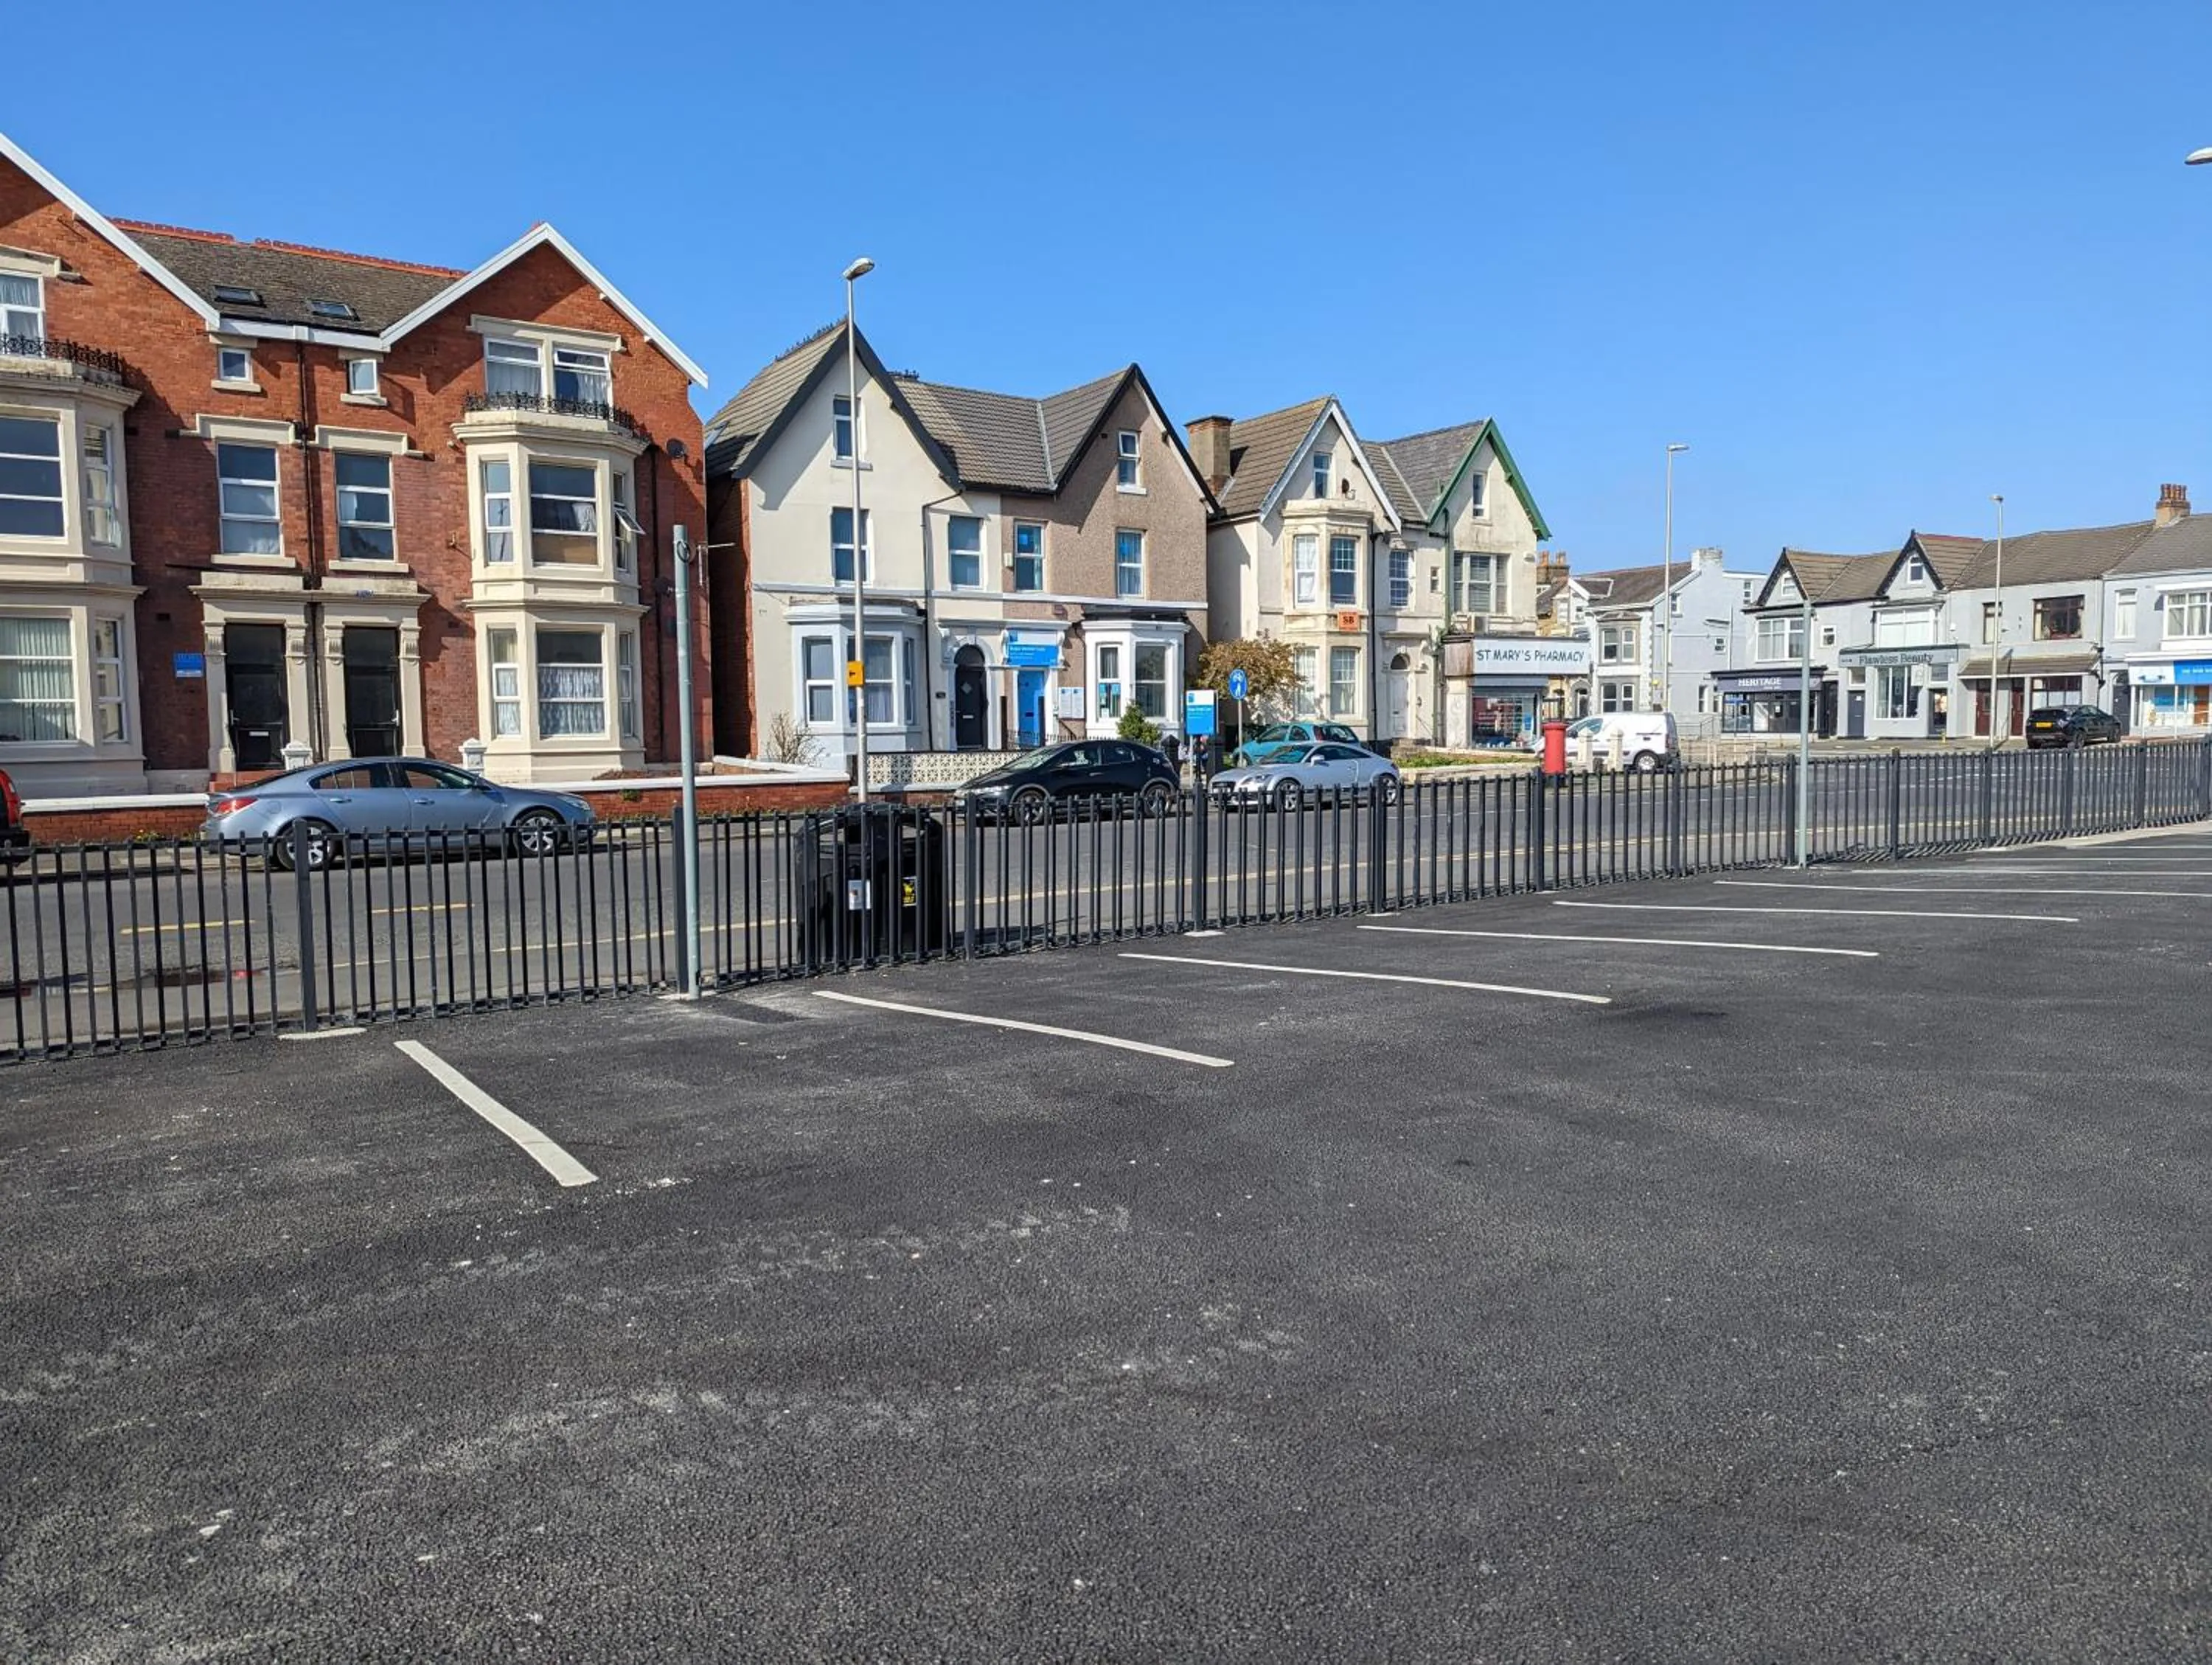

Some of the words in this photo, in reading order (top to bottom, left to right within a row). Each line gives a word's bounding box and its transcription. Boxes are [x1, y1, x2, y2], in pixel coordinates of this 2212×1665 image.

[1476, 649, 1492, 661] ST
[1493, 649, 1532, 661] MARY'S
[1534, 650, 1585, 662] PHARMACY
[1858, 654, 1899, 664] Flawless
[1900, 653, 1934, 664] Beauty
[1738, 677, 1782, 686] HERITAGE
